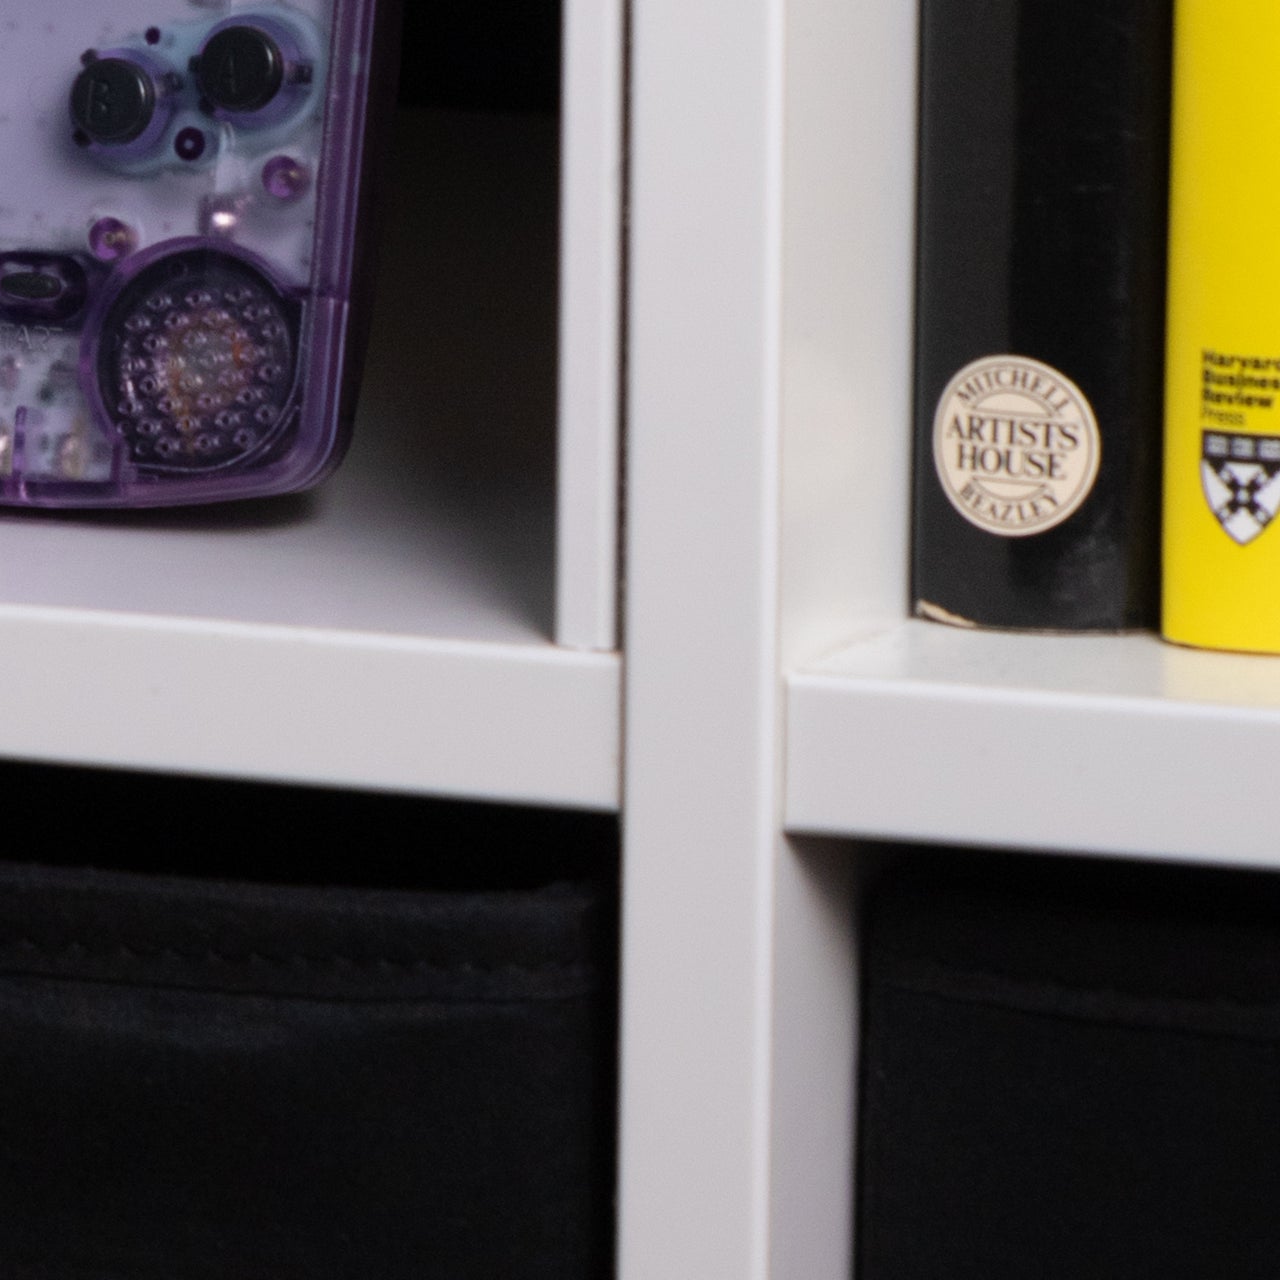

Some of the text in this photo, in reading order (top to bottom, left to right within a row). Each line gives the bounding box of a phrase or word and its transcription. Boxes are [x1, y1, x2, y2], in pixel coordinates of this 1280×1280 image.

[955, 369, 1071, 417] MITCHELL
[1201, 387, 1275, 409] Review
[947, 413, 1081, 451] ARTISTS
[956, 443, 1069, 480] HOUSE
[960, 480, 1060, 523] BEAZLEY
